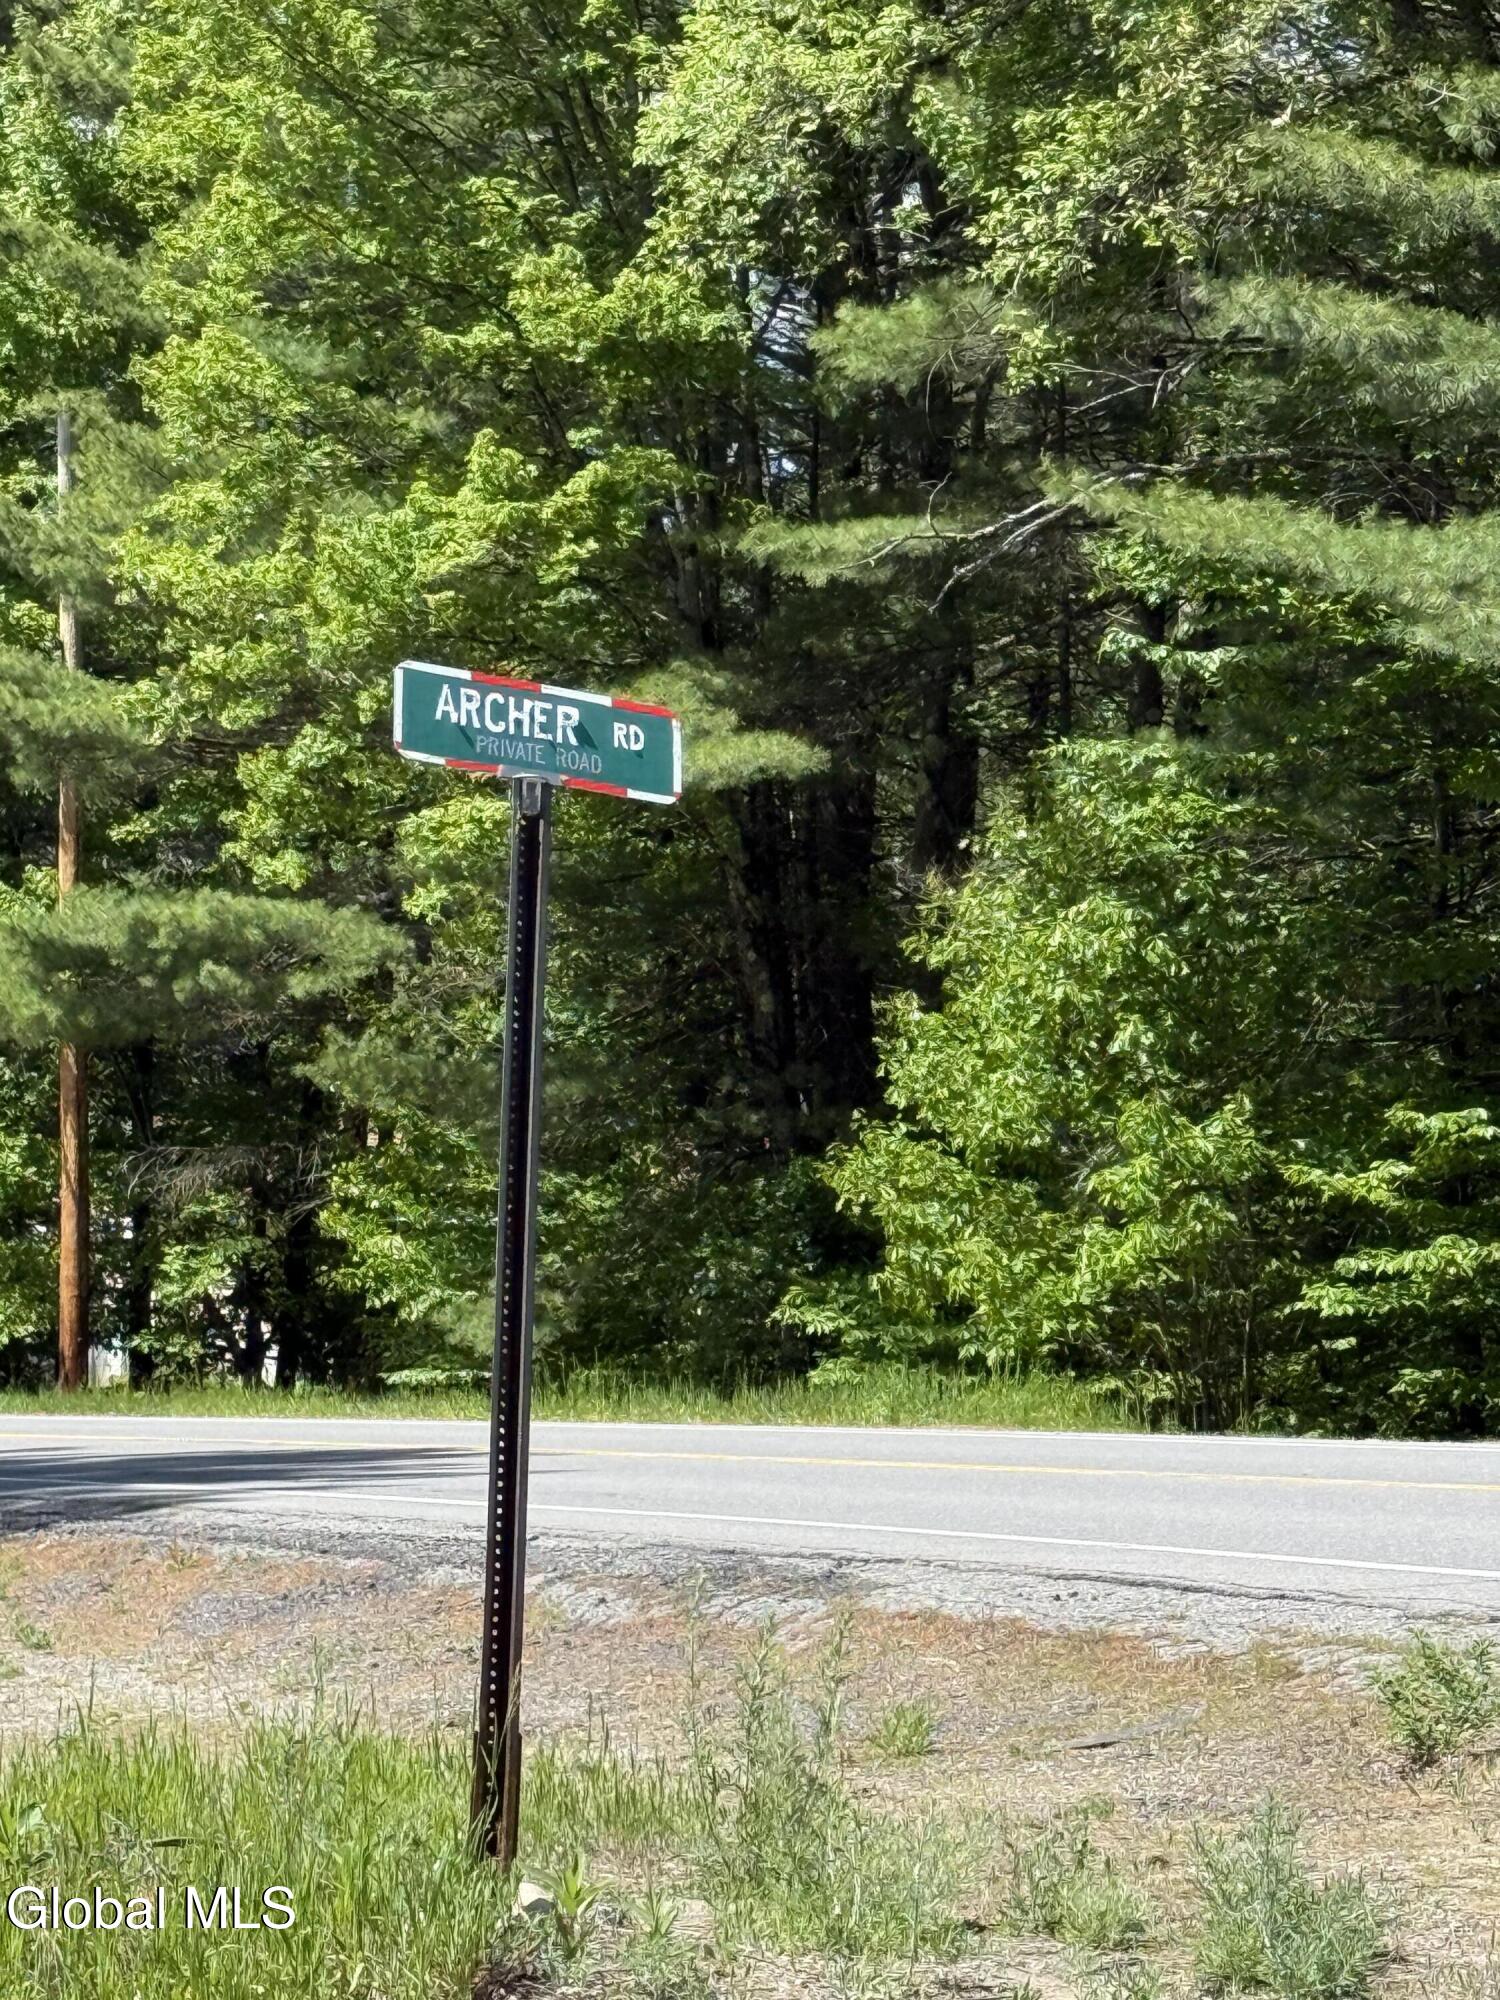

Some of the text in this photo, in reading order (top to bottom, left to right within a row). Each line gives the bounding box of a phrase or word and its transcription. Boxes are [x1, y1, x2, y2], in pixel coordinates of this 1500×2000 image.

[435, 683, 645, 751] ARCHER RD
[476, 735, 602, 774] PRIVATE ROAD
